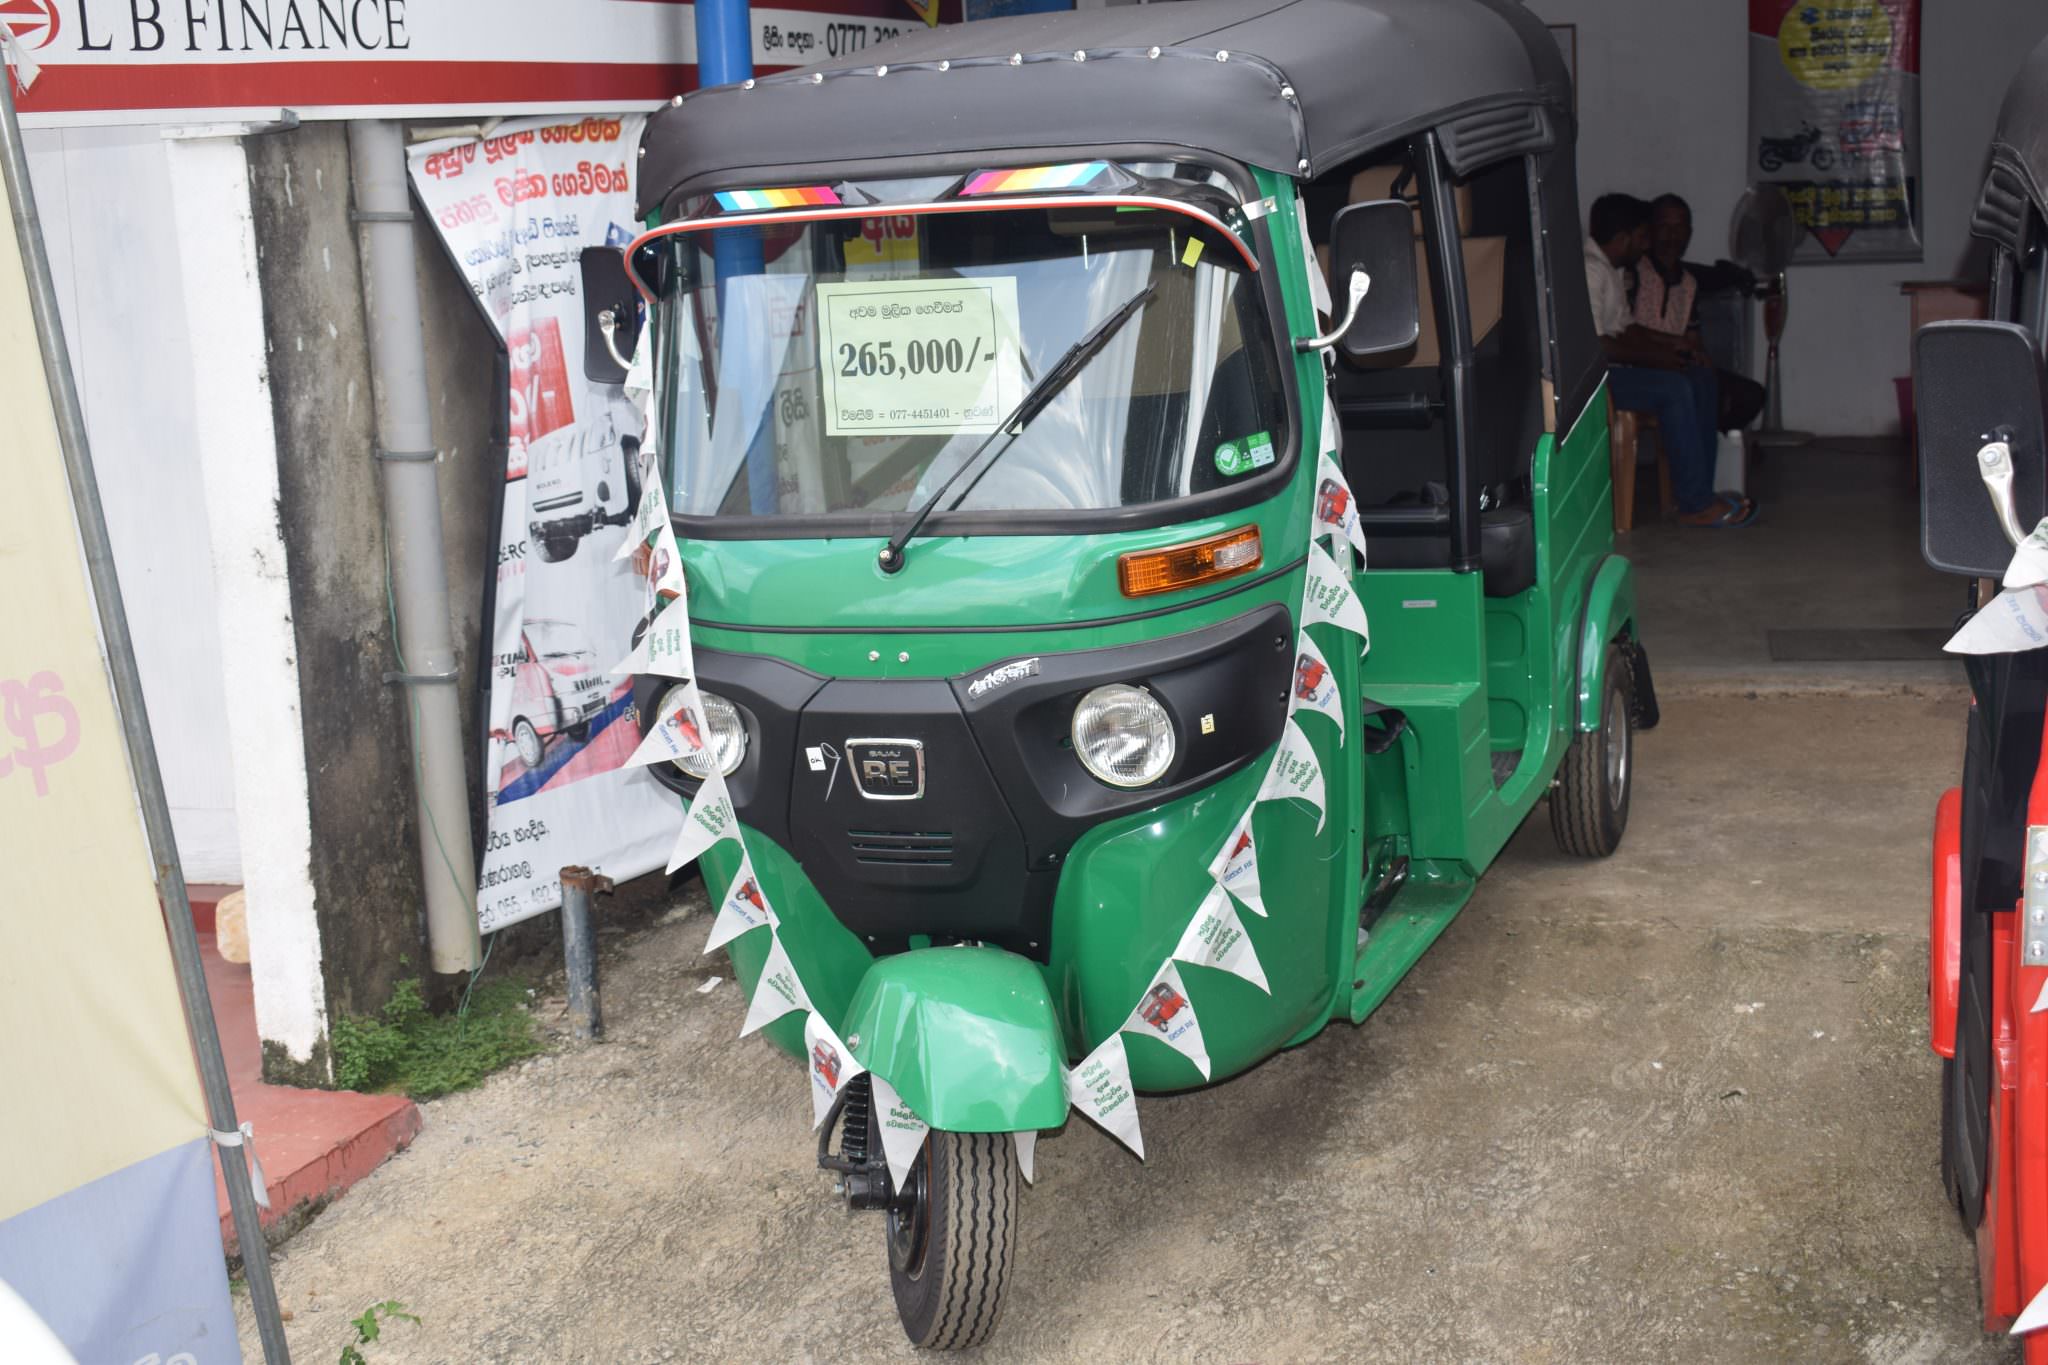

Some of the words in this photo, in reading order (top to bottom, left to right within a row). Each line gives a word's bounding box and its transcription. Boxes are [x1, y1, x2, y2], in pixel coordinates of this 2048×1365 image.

[78, 0, 112, 51] L
[130, 0, 165, 51] B
[184, 0, 411, 52] FINANCE
[826, 22, 867, 57] 0777
[552, 160, 629, 198] ගෙවීමක්
[849, 303, 877, 319] අවම
[916, 300, 963, 316] ගෙවීමක්
[838, 336, 995, 381] 265,000/-
[889, 407, 951, 421] 077-4451401
[862, 760, 913, 786] RE
